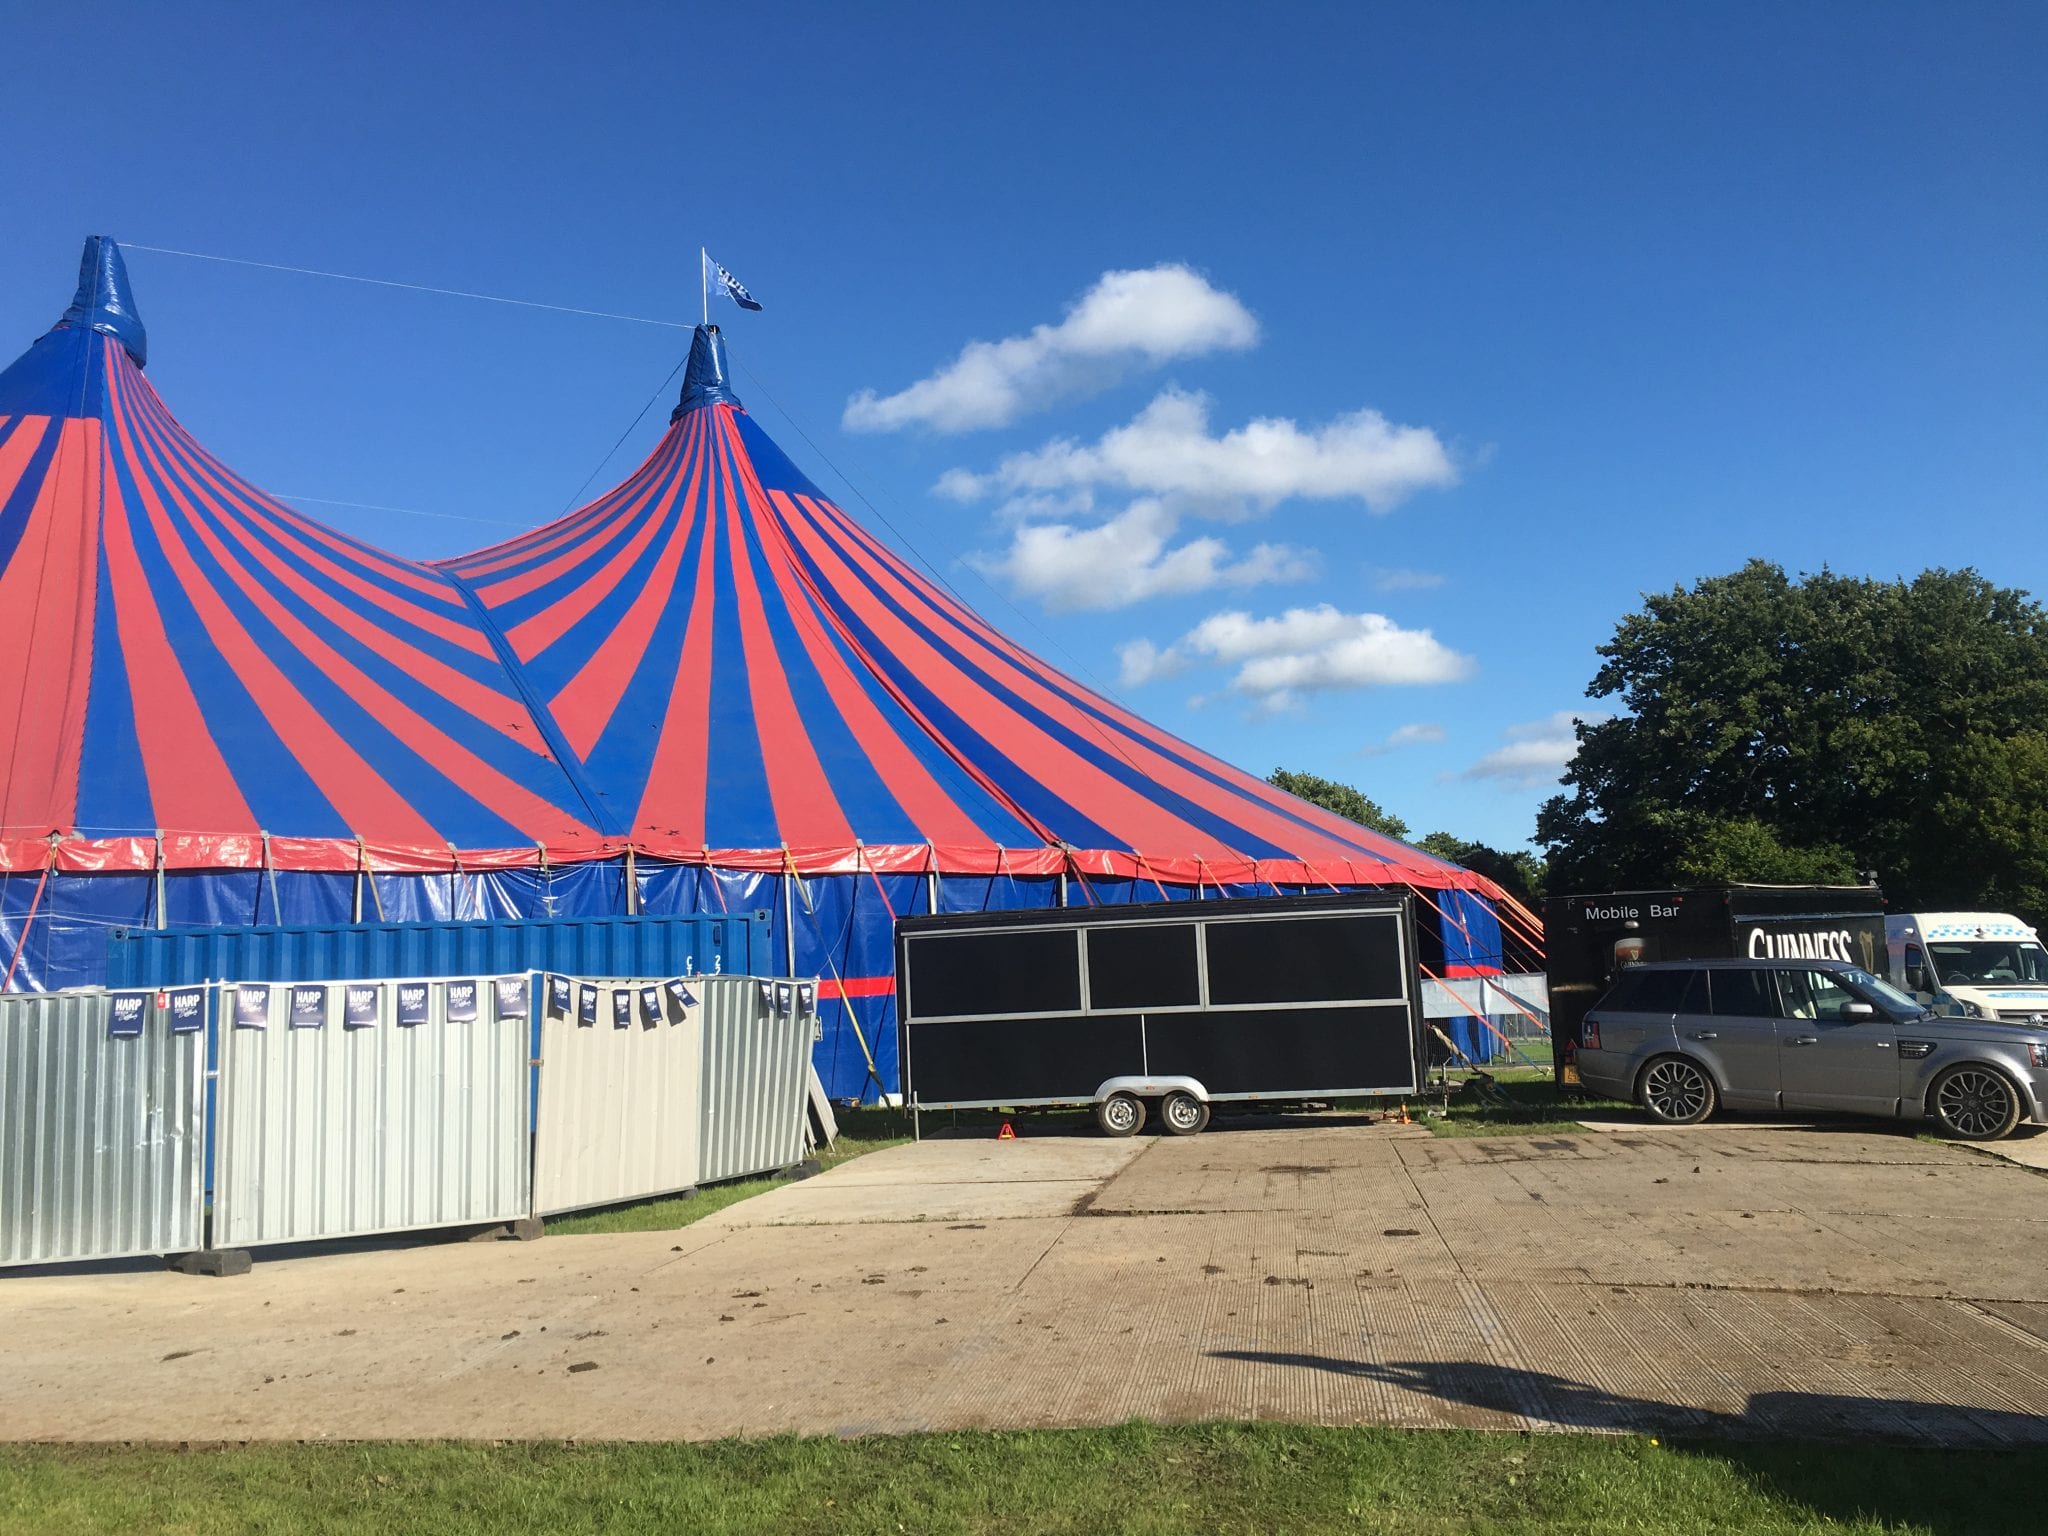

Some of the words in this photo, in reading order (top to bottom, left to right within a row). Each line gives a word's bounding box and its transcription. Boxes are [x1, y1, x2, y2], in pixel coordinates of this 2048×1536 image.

[1585, 906, 1639, 920] Mobile
[1650, 904, 1680, 918] Bar
[1748, 927, 1852, 963] GUINNESS
[401, 988, 425, 1001] HARP
[449, 986, 474, 999] HARP
[499, 981, 522, 995] HARP
[174, 994, 200, 1009] HARP
[239, 990, 266, 1003] HARP
[296, 990, 322, 1003] HARP
[349, 990, 374, 1003] HARP
[115, 998, 143, 1011] HARP
